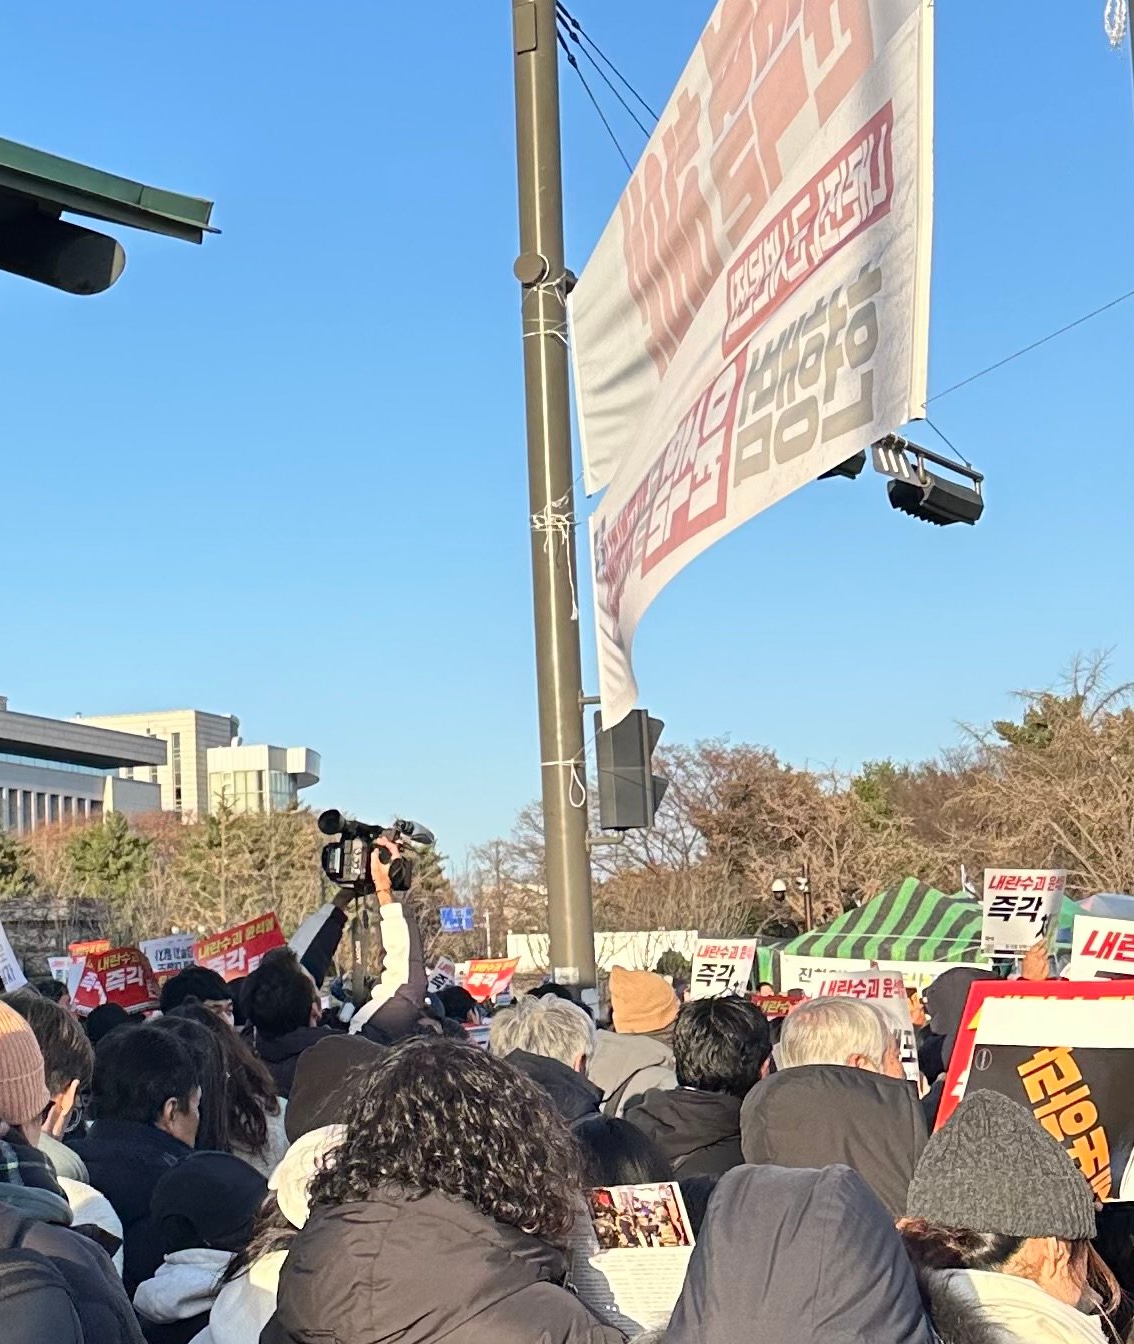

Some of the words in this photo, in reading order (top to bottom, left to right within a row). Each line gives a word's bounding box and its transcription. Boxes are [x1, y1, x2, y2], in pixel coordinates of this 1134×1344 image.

[988, 875, 1046, 891] 내란수괴
[987, 896, 1043, 923] 즉각
[199, 930, 242, 960] 내란수괴
[697, 945, 739, 959] 내란수괴
[106, 966, 144, 992] 즉각
[696, 964, 735, 988] 즉각
[819, 978, 879, 999] 내란수괴
